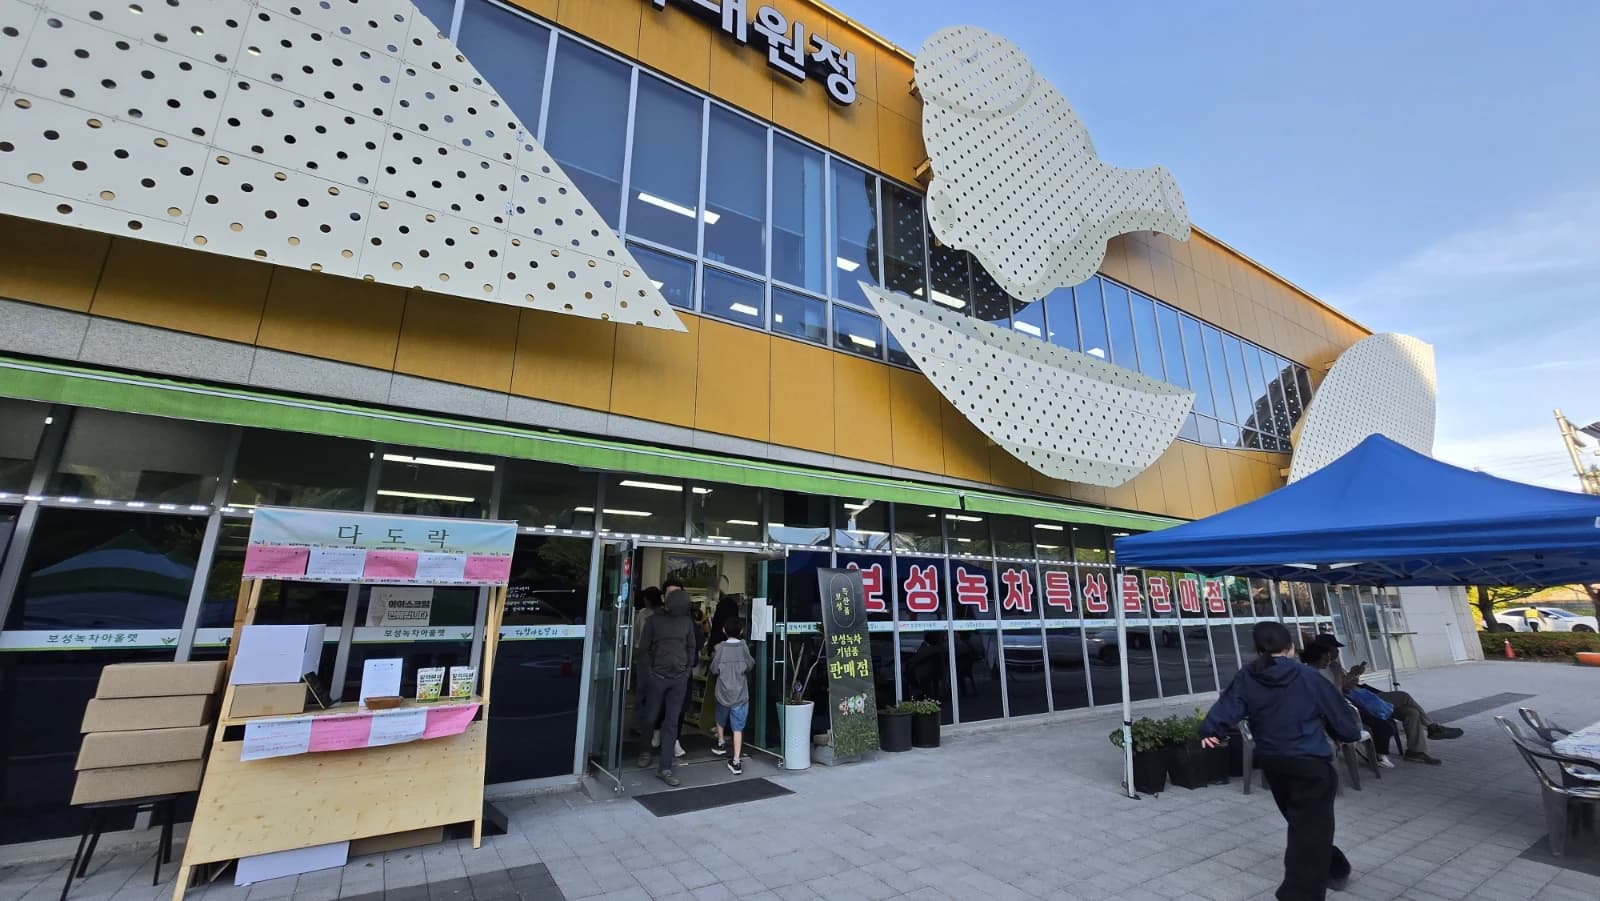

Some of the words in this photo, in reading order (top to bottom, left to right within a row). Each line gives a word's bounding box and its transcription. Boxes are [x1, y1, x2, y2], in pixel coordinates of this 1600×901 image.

[338, 524, 450, 549] 다도락
[47, 633, 139, 643] 보성녹차아울렛
[384, 629, 446, 637] 보성녹차아울렛
[831, 634, 863, 646] 보성녹차
[837, 646, 859, 657] 기념품
[830, 659, 869, 680] 판매점
